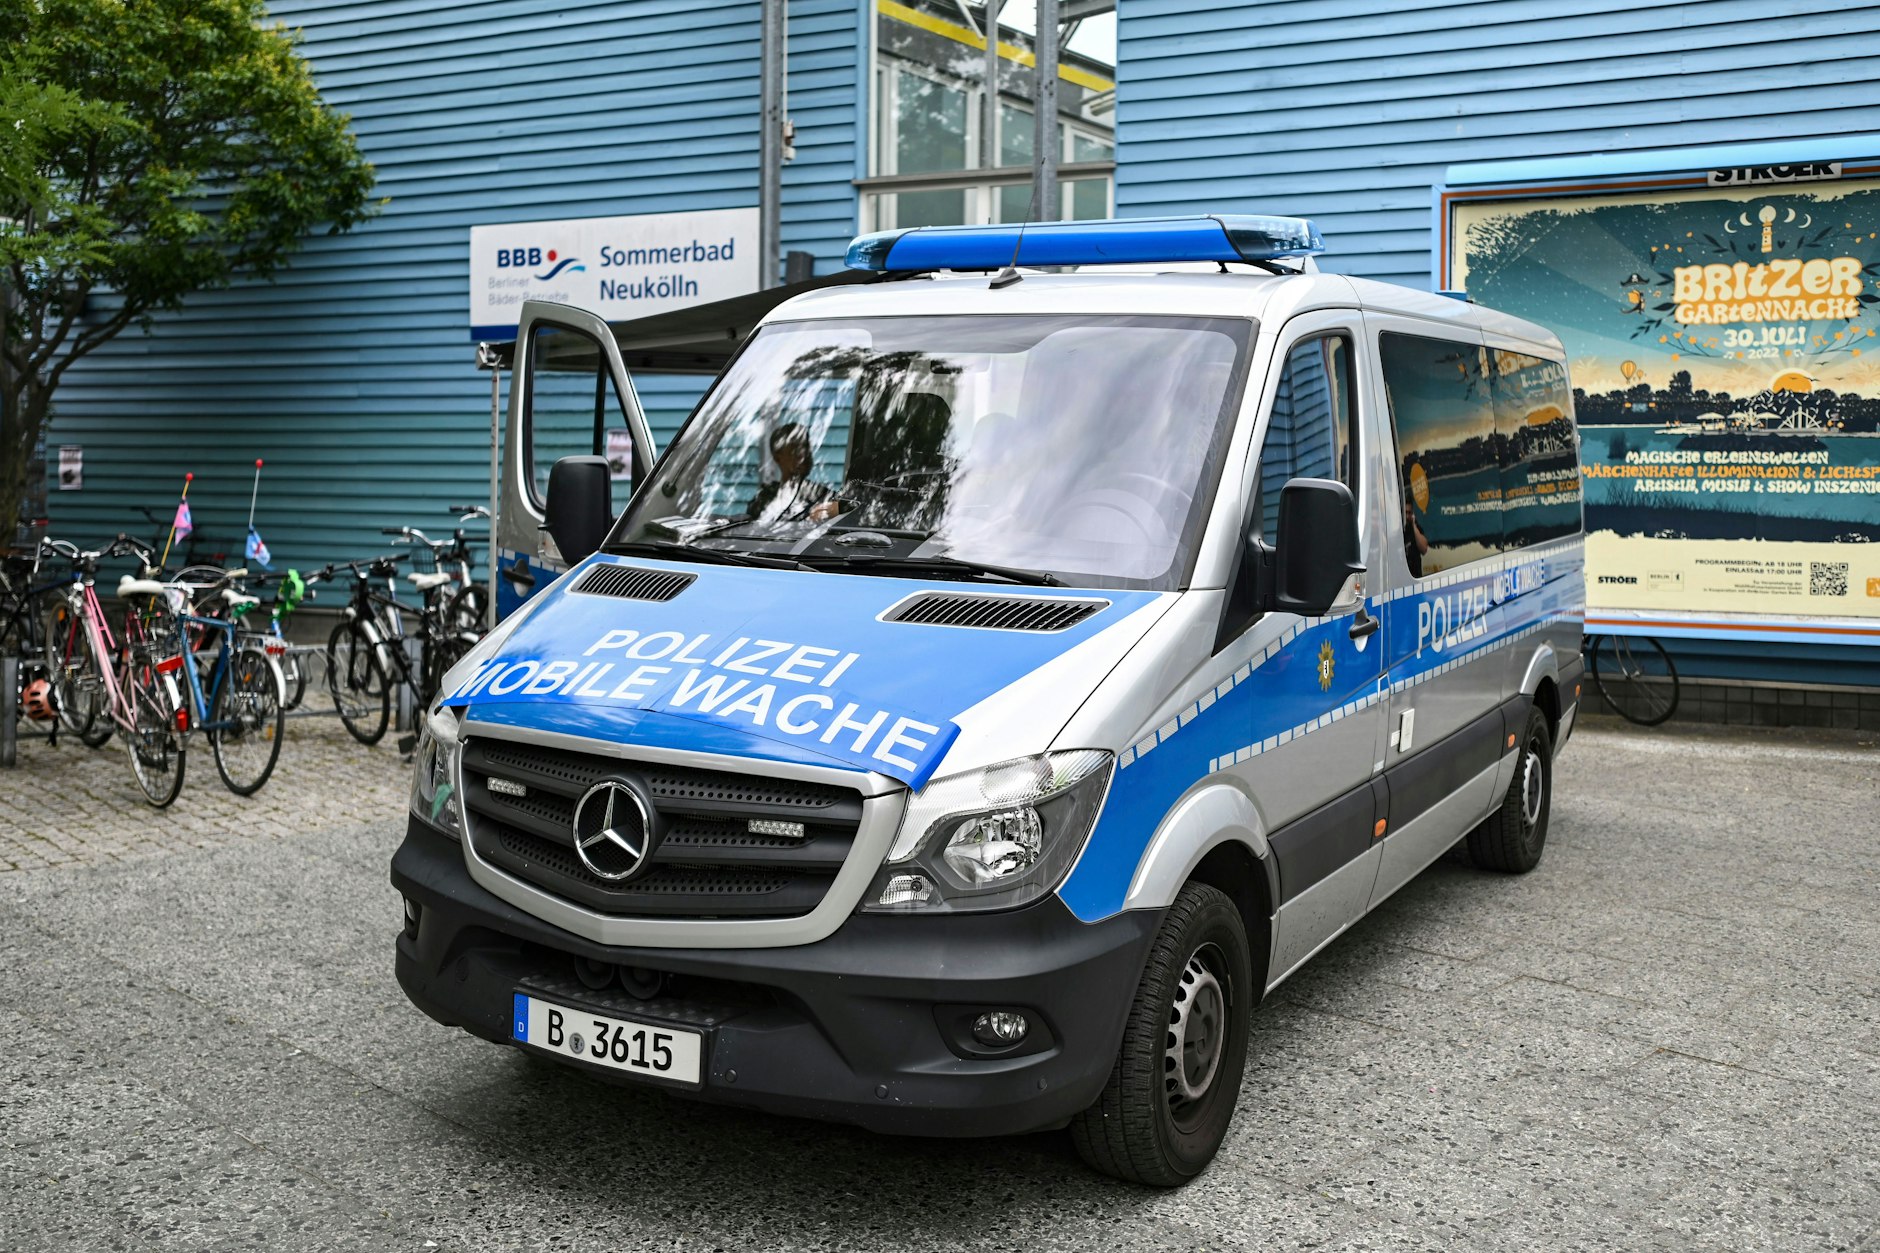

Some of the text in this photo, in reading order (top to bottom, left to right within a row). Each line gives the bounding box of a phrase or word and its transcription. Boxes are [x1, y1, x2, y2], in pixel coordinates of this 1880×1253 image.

[496, 248, 542, 269] BBB
[600, 237, 735, 267] Sommerbad
[488, 276, 530, 289] Berliner
[600, 275, 698, 301] Neukölln
[1748, 347, 1780, 360] 2022
[1803, 465, 1816, 479] &
[1753, 480, 1764, 493] &
[1766, 480, 1811, 494] SHOW
[1598, 575, 1638, 585] STRÖER
[1416, 583, 1488, 659] POLIZEI
[583, 628, 861, 688] POLIZEI
[459, 660, 941, 771] MOBILE WACHE
[518, 1021, 525, 1033] D
[547, 1008, 673, 1071] B 3615
